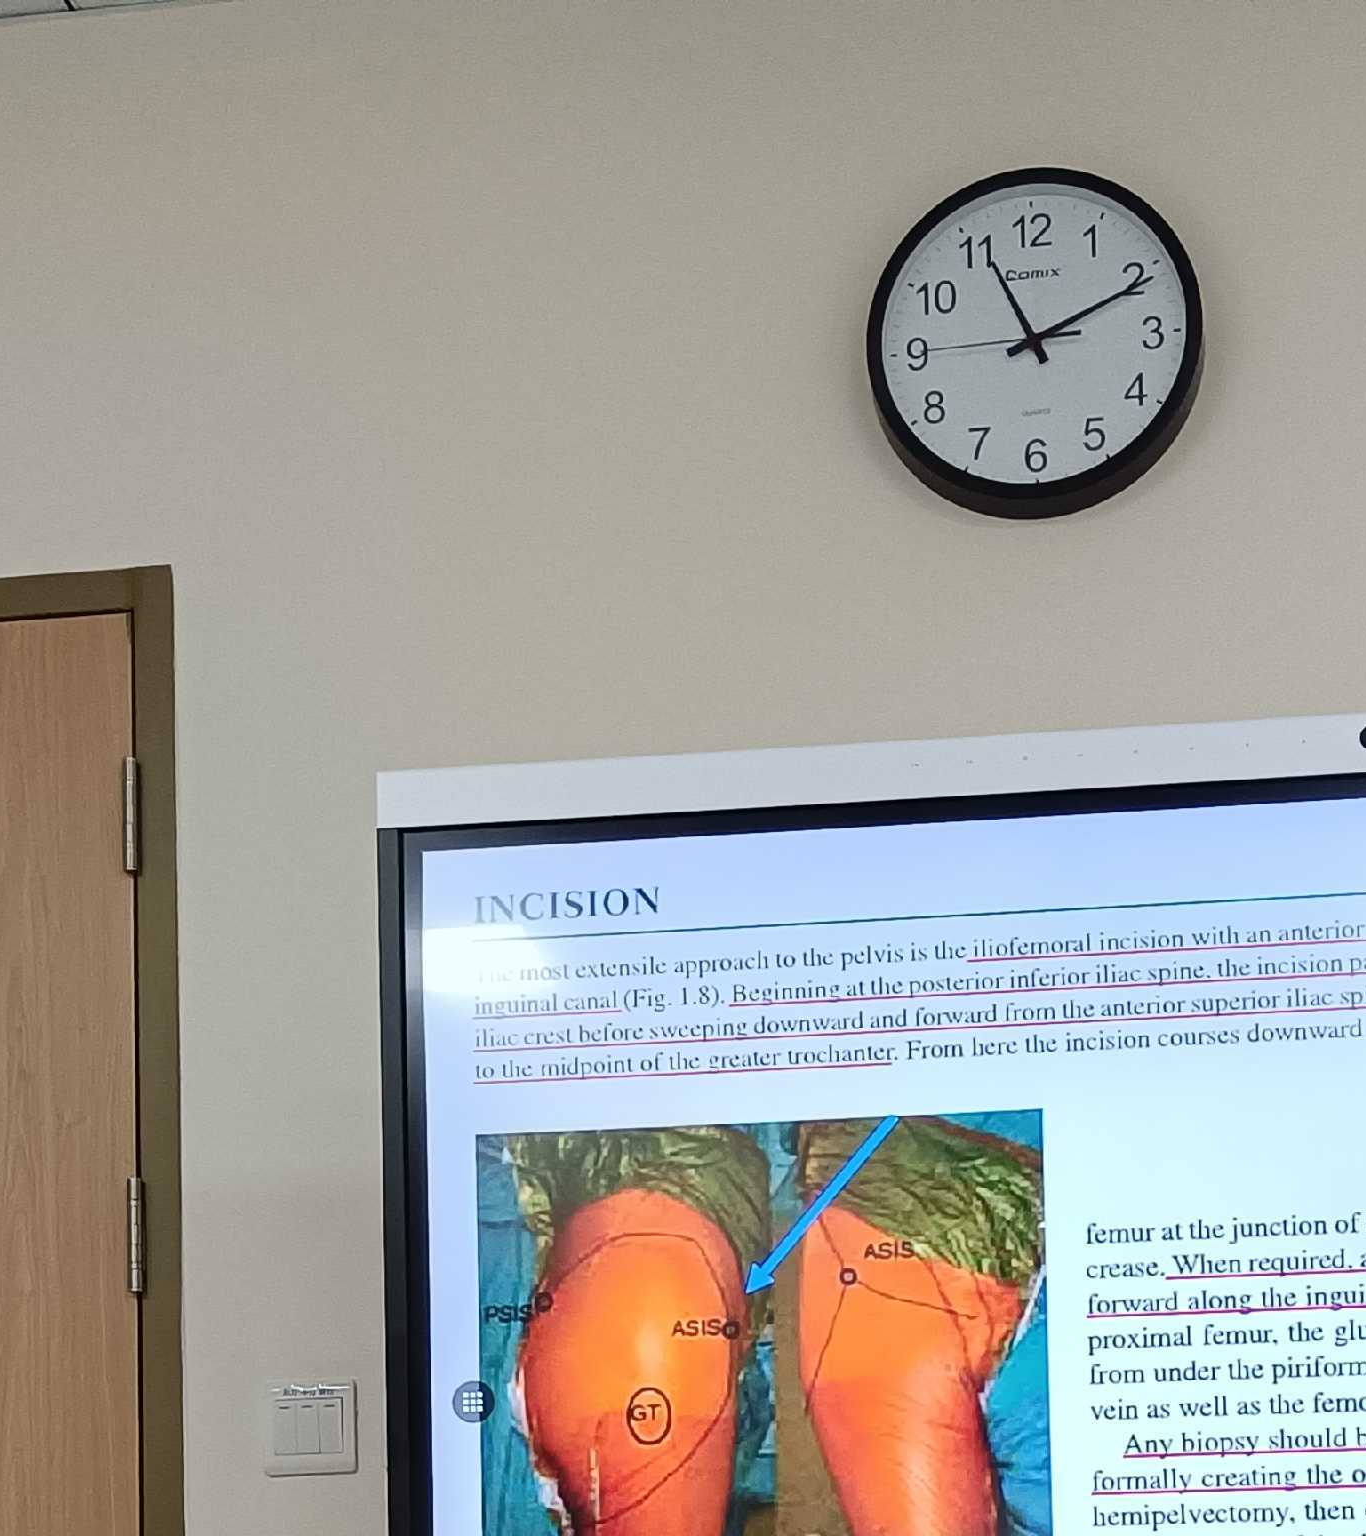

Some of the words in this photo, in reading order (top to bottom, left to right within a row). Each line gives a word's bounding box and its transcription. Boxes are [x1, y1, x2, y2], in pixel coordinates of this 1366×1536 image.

[1011, 213, 1052, 248] 12
[1082, 225, 1098, 259] 1
[959, 235, 992, 269] 11
[1122, 262, 1145, 296] 2
[916, 280, 957, 316] 10
[1142, 316, 1165, 350] 3
[906, 338, 929, 372] 9
[1124, 372, 1148, 407] 4
[924, 391, 946, 425] 8
[968, 427, 991, 461] 7
[1083, 417, 1106, 451] 5
[1025, 439, 1048, 473] 6
[474, 887, 658, 922] INCISION
[474, 1028, 517, 1053] iliac
[522, 1027, 571, 1051] crest
[577, 1022, 643, 1048] before
[647, 1017, 746, 1040] sweeping
[751, 1010, 863, 1038] downward
[868, 1007, 907, 1029] and
[913, 1003, 997, 1027] forward
[1004, 1002, 1055, 1022] from
[1061, 999, 1094, 1024] the
[1099, 995, 1185, 1021] anterior
[1189, 990, 1280, 1015] superior
[1285, 987, 1332, 1008] iliac
[474, 1064, 494, 1085] to
[500, 1059, 532, 1083] the
[539, 1054, 632, 1082] midpoint
[638, 1051, 663, 1072] of
[667, 1051, 699, 1071] the
[707, 1051, 780, 1069] greater
[786, 1044, 897, 1066] trochanter.
[905, 1039, 963, 1061] From
[971, 1036, 1017, 1057] here
[1023, 1034, 1057, 1054] the
[1064, 1029, 1149, 1053] incision
[1156, 1029, 1239, 1047] courses
[1245, 1018, 1361, 1043] downward
[1084, 1222, 1155, 1245] femur
[1159, 1223, 1182, 1241] at
[1188, 1219, 1224, 1240] the
[1231, 1214, 1327, 1245] junction
[1333, 1211, 1361, 1234] of
[863, 1241, 916, 1260] ASIS
[671, 1319, 722, 1338] ASIS
[630, 1404, 661, 1423] GT
[1092, 1503, 1295, 1532] hemipelvectomy,
[1303, 1499, 1354, 1521] then
